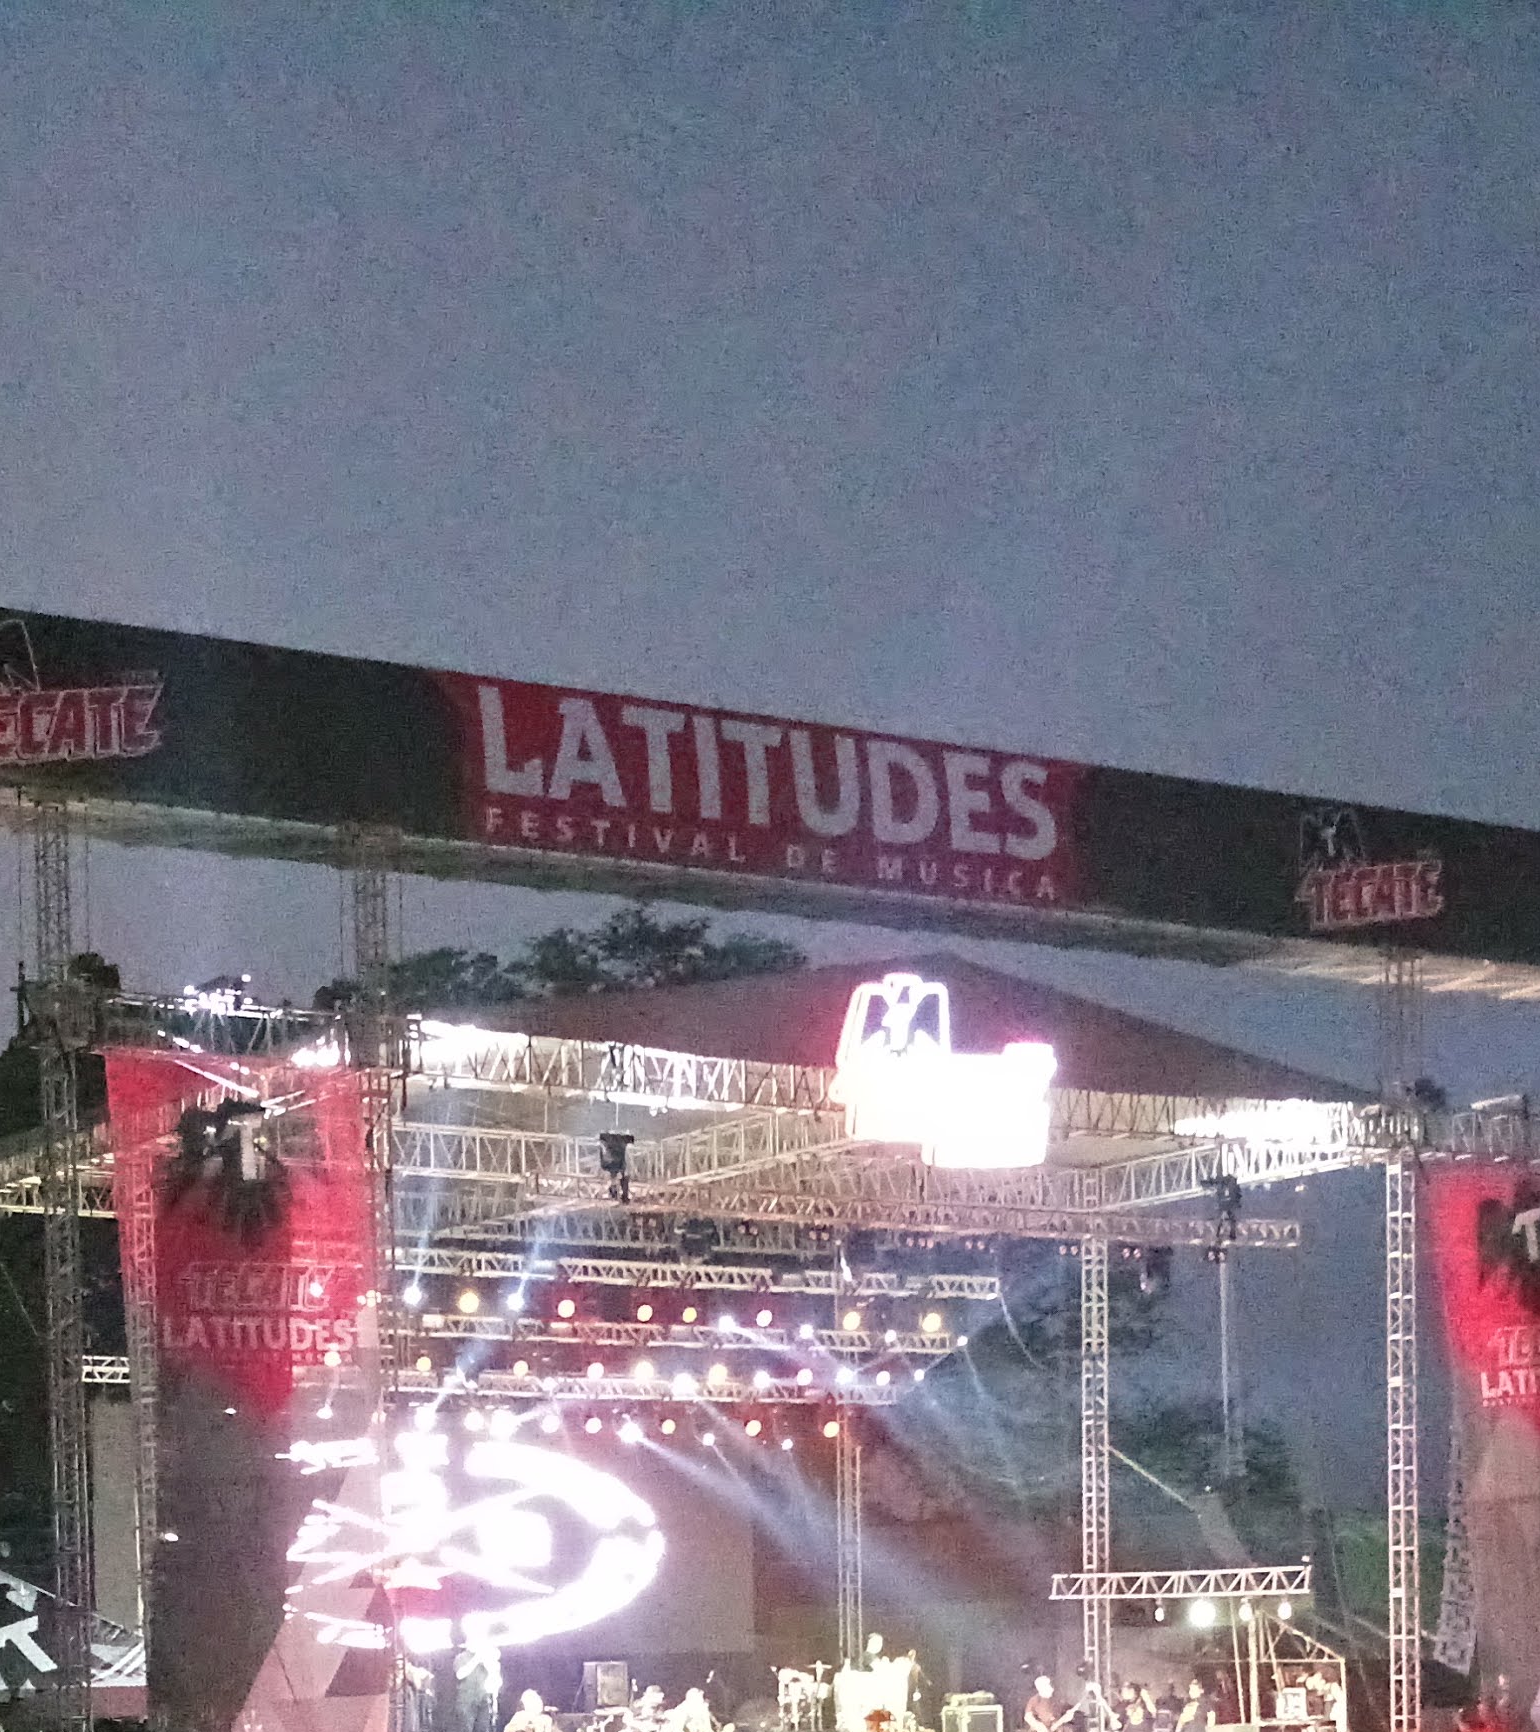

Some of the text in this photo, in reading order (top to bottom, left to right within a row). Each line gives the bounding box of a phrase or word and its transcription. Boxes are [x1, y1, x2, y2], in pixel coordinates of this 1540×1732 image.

[477, 685, 1058, 861] LATITUDES
[485, 806, 1056, 901] FESTIVAL DE MUSICA
[163, 1315, 354, 1351] LATITUDES
